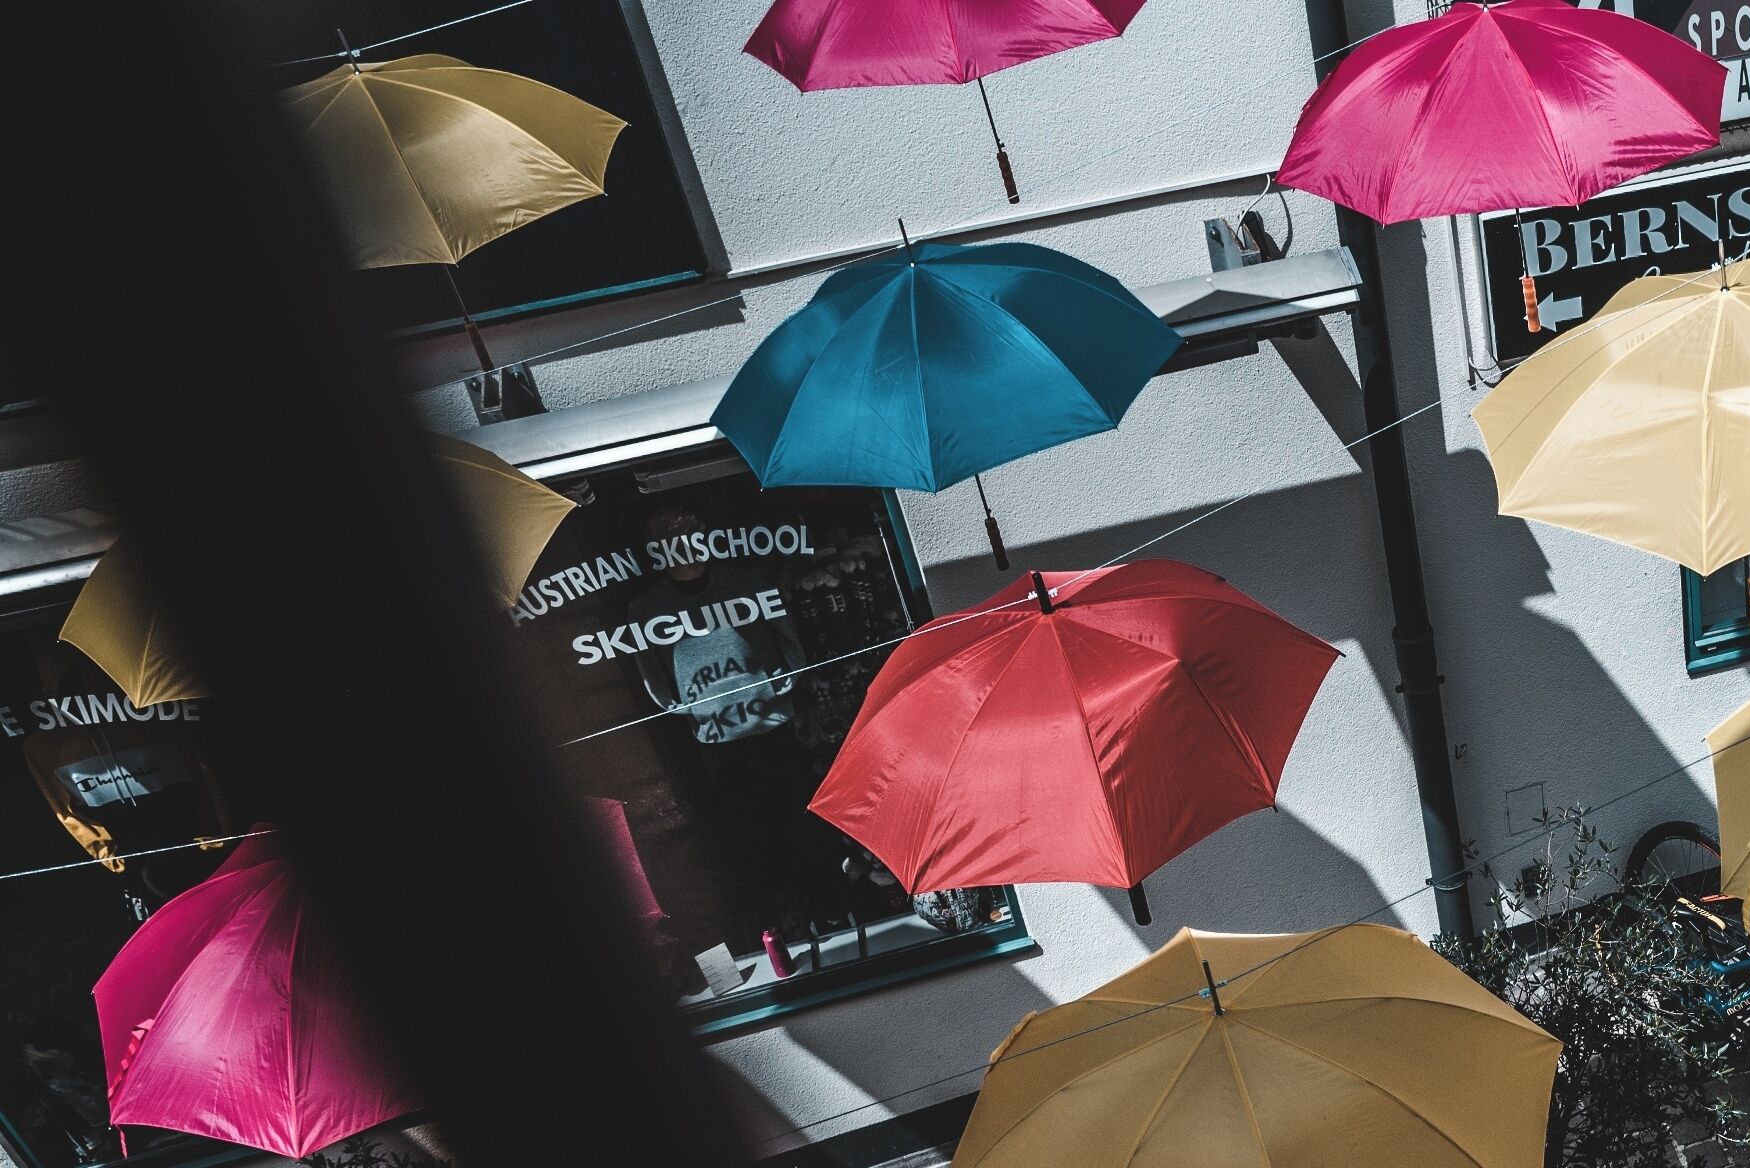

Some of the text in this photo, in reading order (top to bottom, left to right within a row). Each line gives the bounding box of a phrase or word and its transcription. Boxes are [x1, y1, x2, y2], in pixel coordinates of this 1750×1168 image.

[508, 525, 814, 628] AUSTRIAN SKISCHOOL
[572, 588, 788, 666] SKIGUIDE
